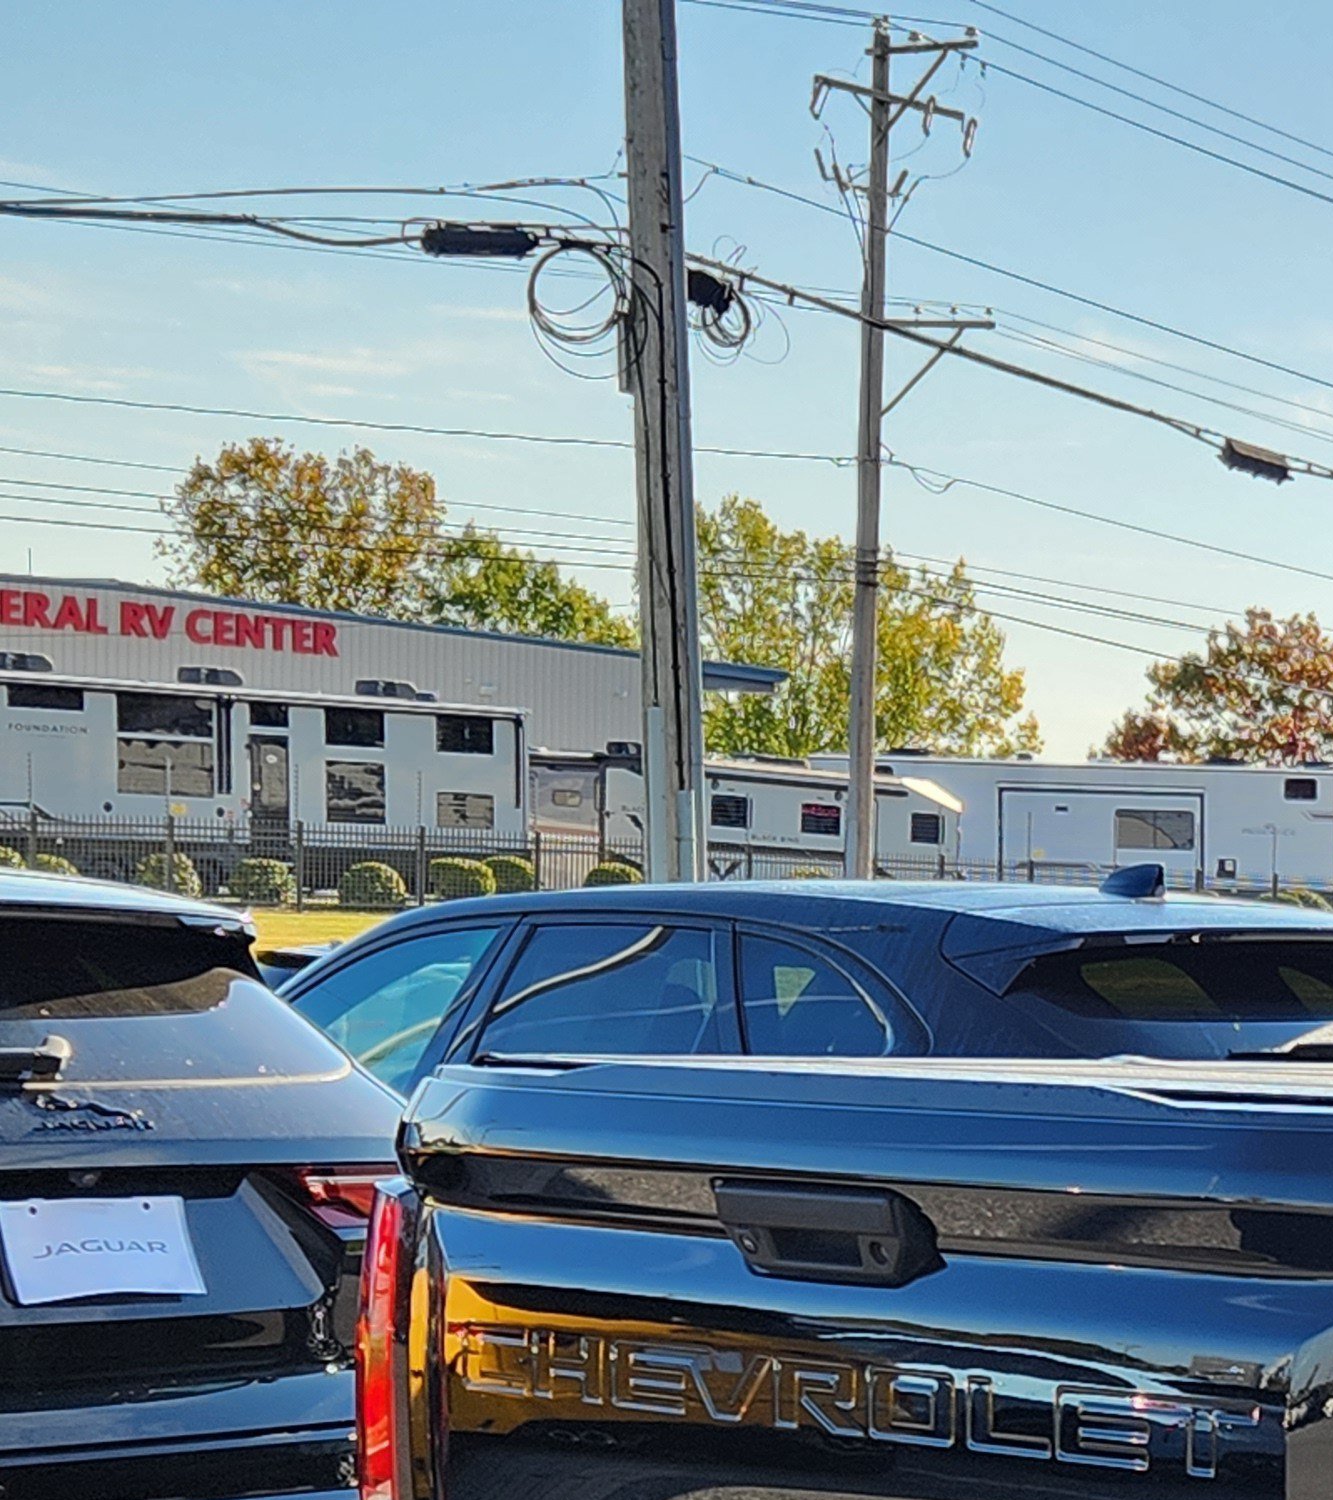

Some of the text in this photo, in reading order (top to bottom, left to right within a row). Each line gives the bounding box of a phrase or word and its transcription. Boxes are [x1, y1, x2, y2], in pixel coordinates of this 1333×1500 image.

[120, 602, 175, 639] RV
[185, 608, 339, 657] CENTER
[33, 1239, 168, 1259] JAGUAR
[463, 1325, 1260, 1478] CHEVROLET
